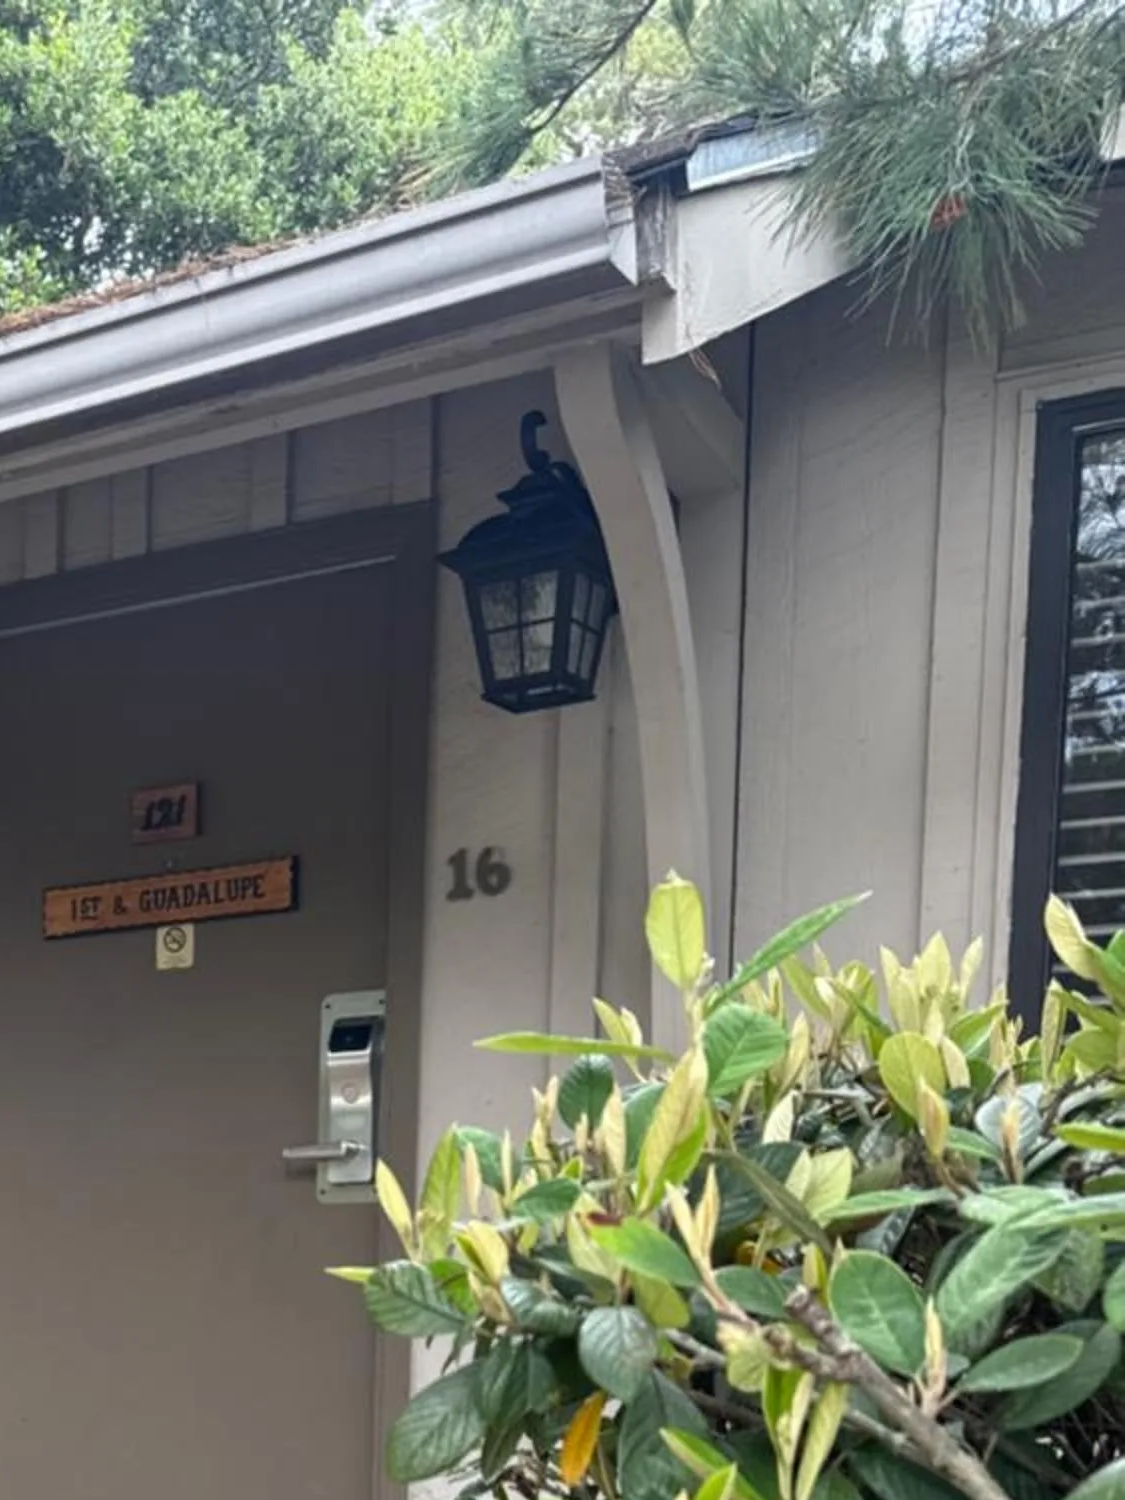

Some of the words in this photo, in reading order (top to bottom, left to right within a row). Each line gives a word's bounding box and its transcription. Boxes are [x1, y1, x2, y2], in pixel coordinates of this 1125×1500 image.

[112, 896, 129, 916] &
[138, 874, 267, 913] GUADALUPE
[446, 846, 512, 902] 16
